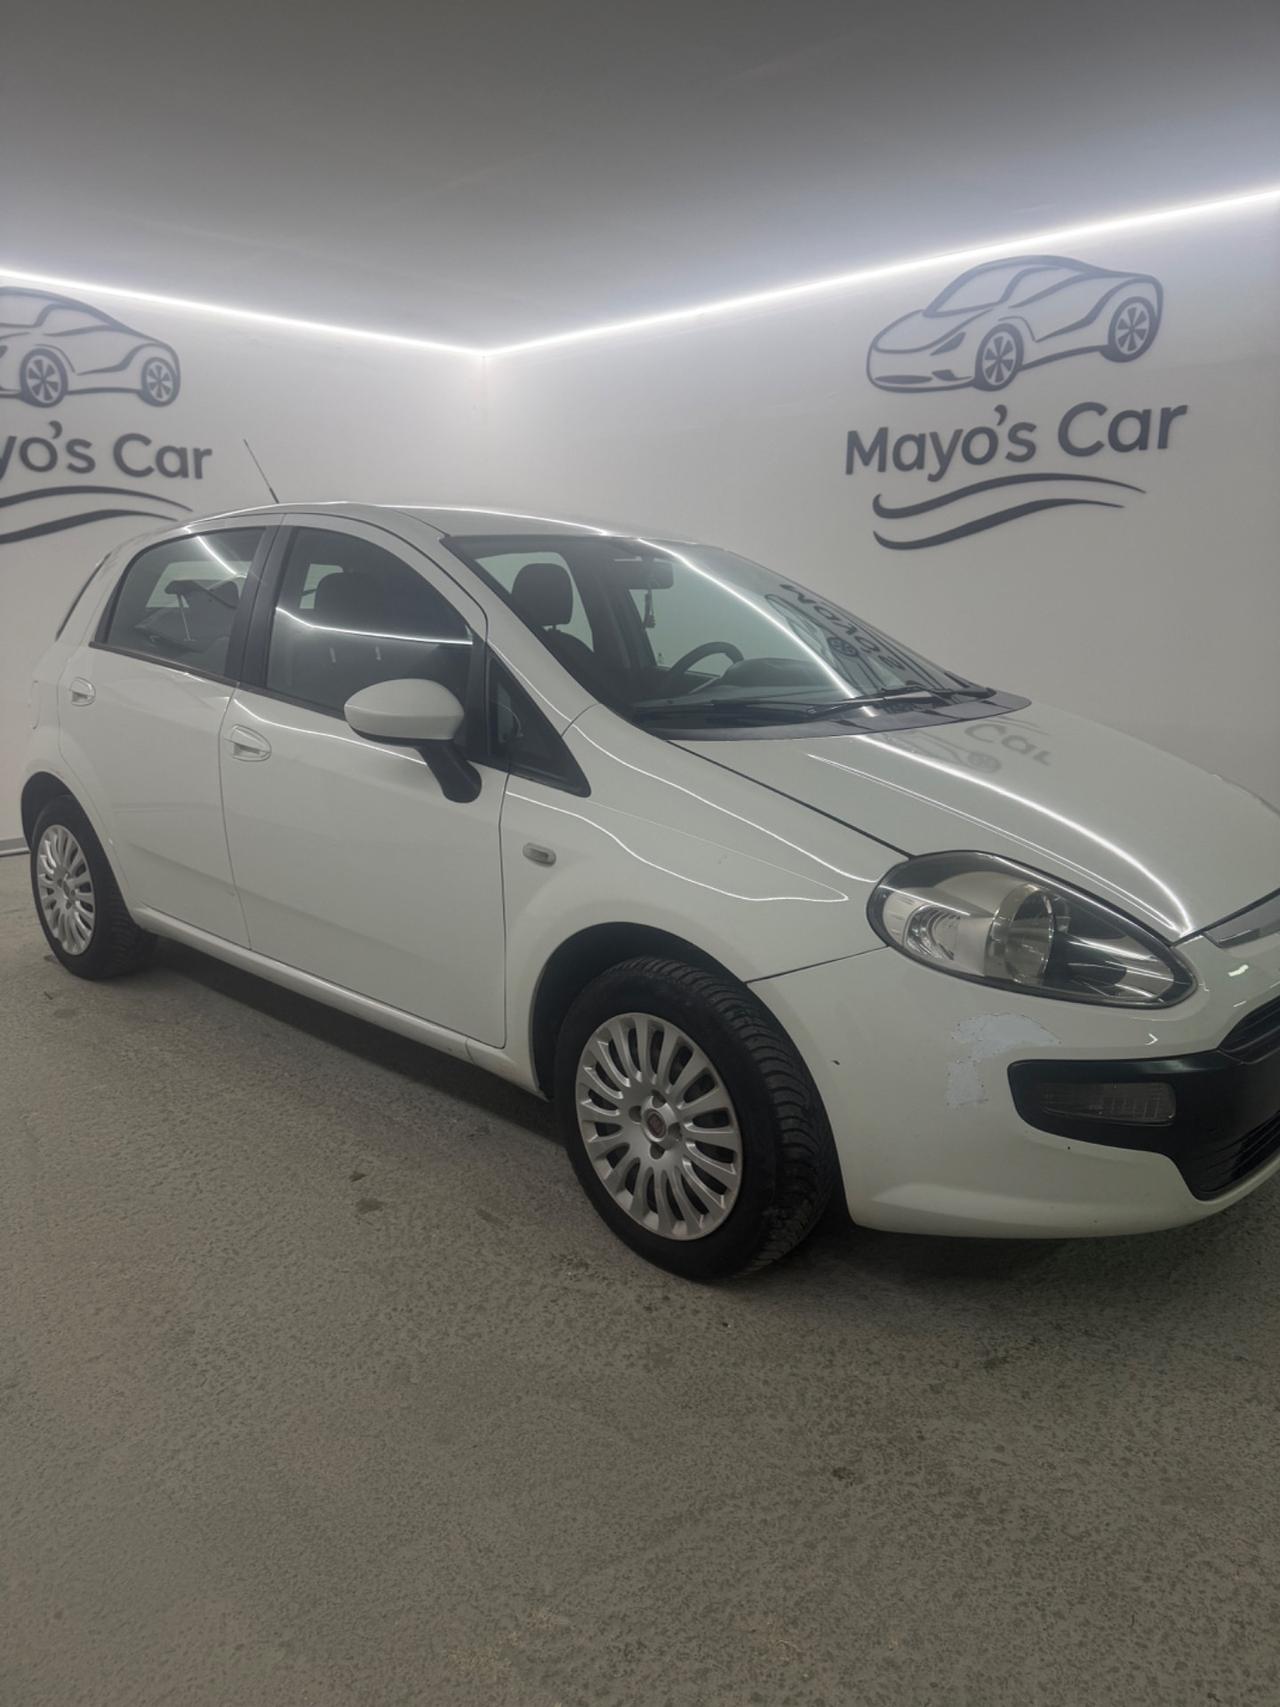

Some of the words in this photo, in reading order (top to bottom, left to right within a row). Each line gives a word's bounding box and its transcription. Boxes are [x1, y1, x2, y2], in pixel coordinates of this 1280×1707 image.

[113, 433, 212, 480] Car
[845, 404, 1037, 483] Mayo's
[1058, 401, 1188, 457] Car
